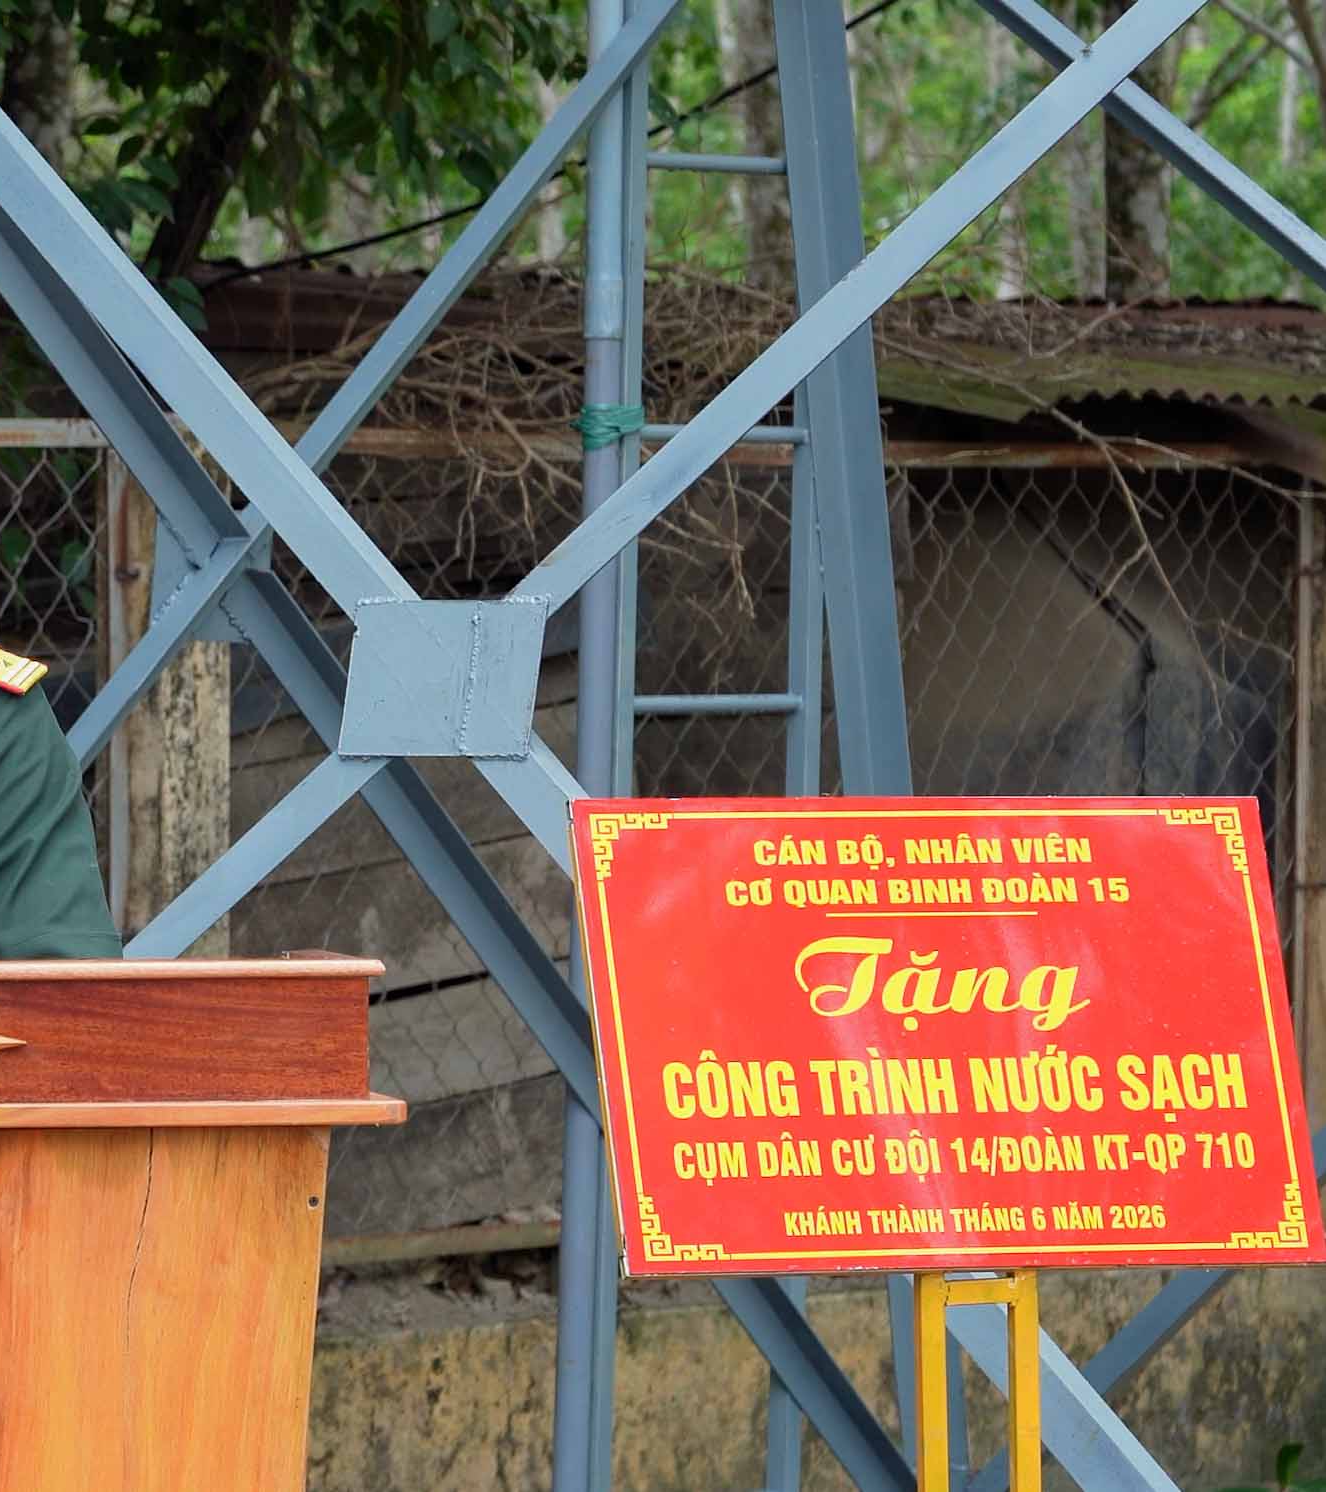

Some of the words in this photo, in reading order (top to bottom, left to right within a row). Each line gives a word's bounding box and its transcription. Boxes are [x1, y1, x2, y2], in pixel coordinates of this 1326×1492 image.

[754, 835, 826, 865] CÁN
[837, 834, 895, 870] BỘ,
[905, 833, 1002, 864] NHÂN
[1011, 833, 1091, 863] VIÊN
[726, 878, 772, 906] CƠ
[784, 880, 878, 907] QUAN
[888, 879, 972, 903] BINH
[982, 873, 1077, 903] ĐOÀN
[1088, 878, 1129, 902] 15
[795, 937, 1090, 1031] Tặng
[663, 1050, 800, 1119] CÔNG
[809, 1047, 958, 1115] TRÌNH
[969, 1045, 1103, 1112] NƯỚC
[1117, 1054, 1247, 1122] SẠCH
[674, 1142, 748, 1186] CỤM
[757, 1132, 822, 1177] DÂN
[832, 1134, 875, 1176] CƯ
[885, 1129, 941, 1183] ĐỘI
[951, 1127, 1085, 1176] 14/ĐOÀN
[1093, 1134, 1186, 1174] KT-QP
[1195, 1132, 1255, 1168] 710
[784, 1206, 862, 1236] KHÁNH
[868, 1204, 944, 1233] THÀNH
[950, 1202, 1026, 1232] THÁNG
[1032, 1207, 1046, 1230] 6
[1052, 1202, 1103, 1230] NĂM
[1110, 1205, 1166, 1228] 2026
